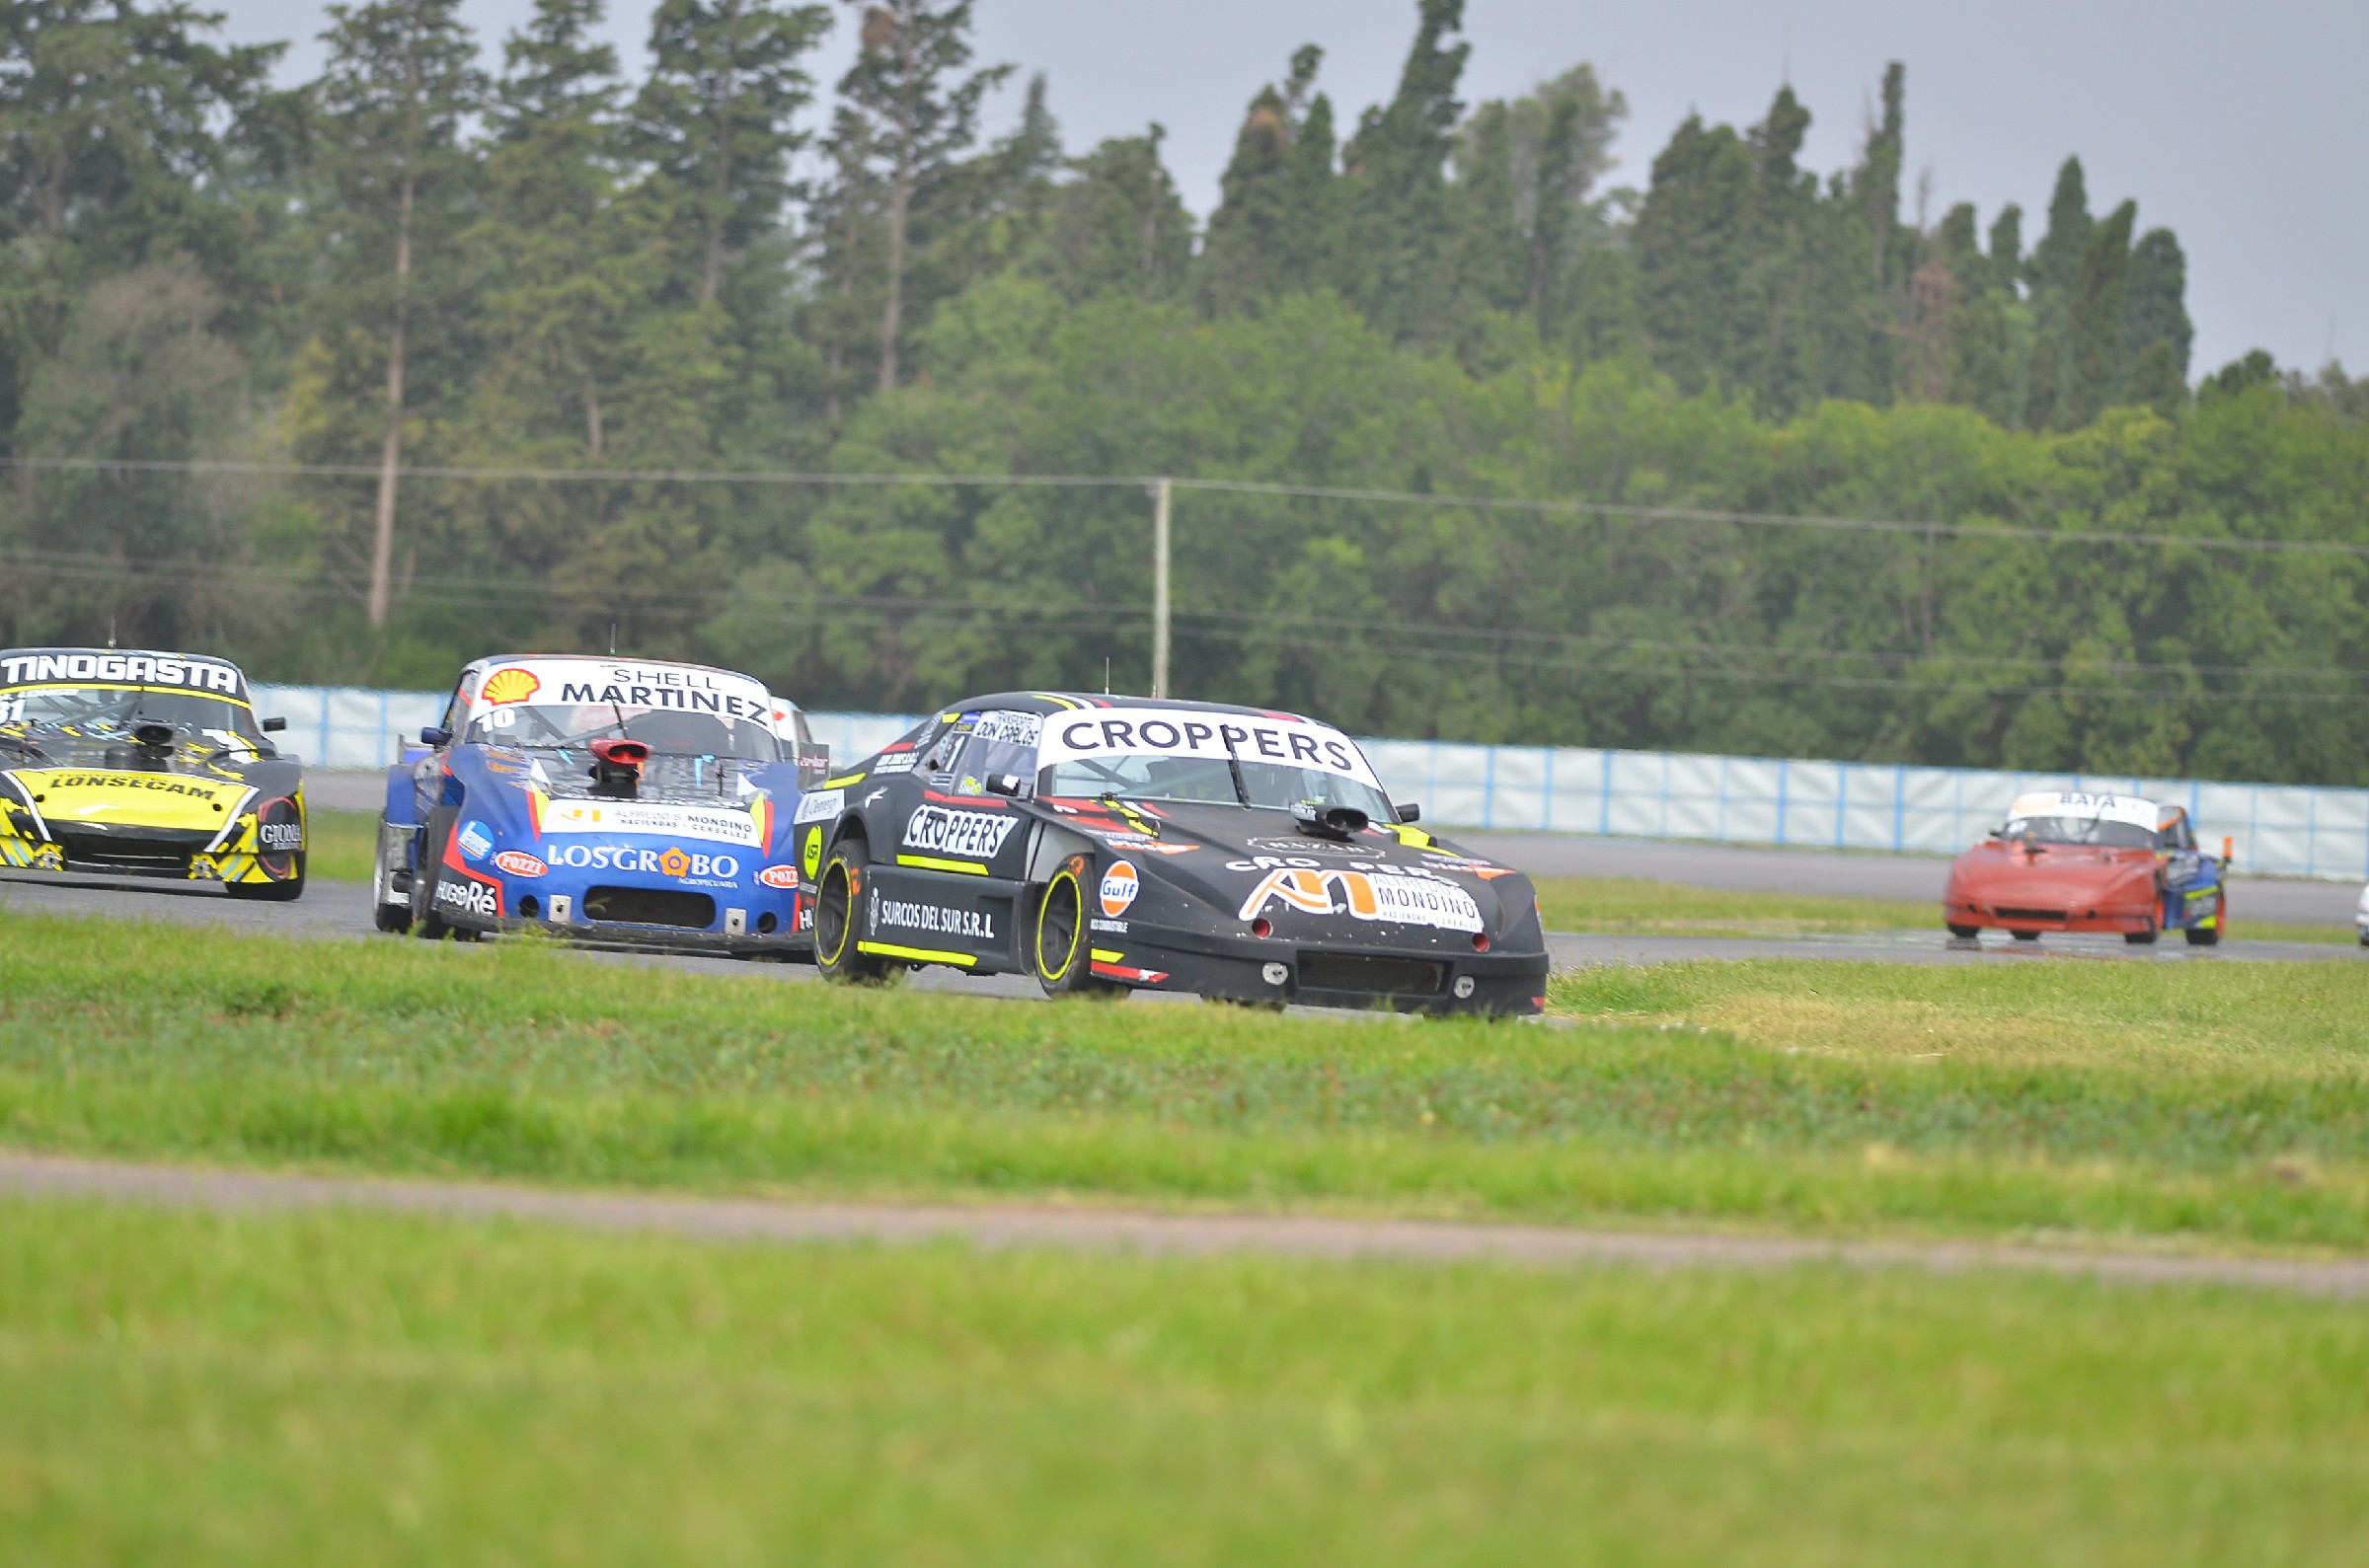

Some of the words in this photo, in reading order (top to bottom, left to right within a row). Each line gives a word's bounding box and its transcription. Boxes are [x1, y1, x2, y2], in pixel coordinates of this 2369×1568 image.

[1, 654, 238, 694] TINOGASTA
[613, 669, 722, 692] SHELL
[478, 708, 516, 733] 10
[561, 683, 769, 727] MARTINEZ
[1062, 719, 1352, 772] CROPPERS
[49, 776, 216, 801] LONSECAM
[687, 815, 752, 833] MONDINO
[908, 808, 1005, 856] CROPPERS
[1103, 880, 1136, 898] Gulf
[1378, 886, 1477, 919] MONDINO
[881, 899, 920, 929] SURCOS
[921, 905, 939, 931] DEL
[941, 908, 961, 933] SUR
